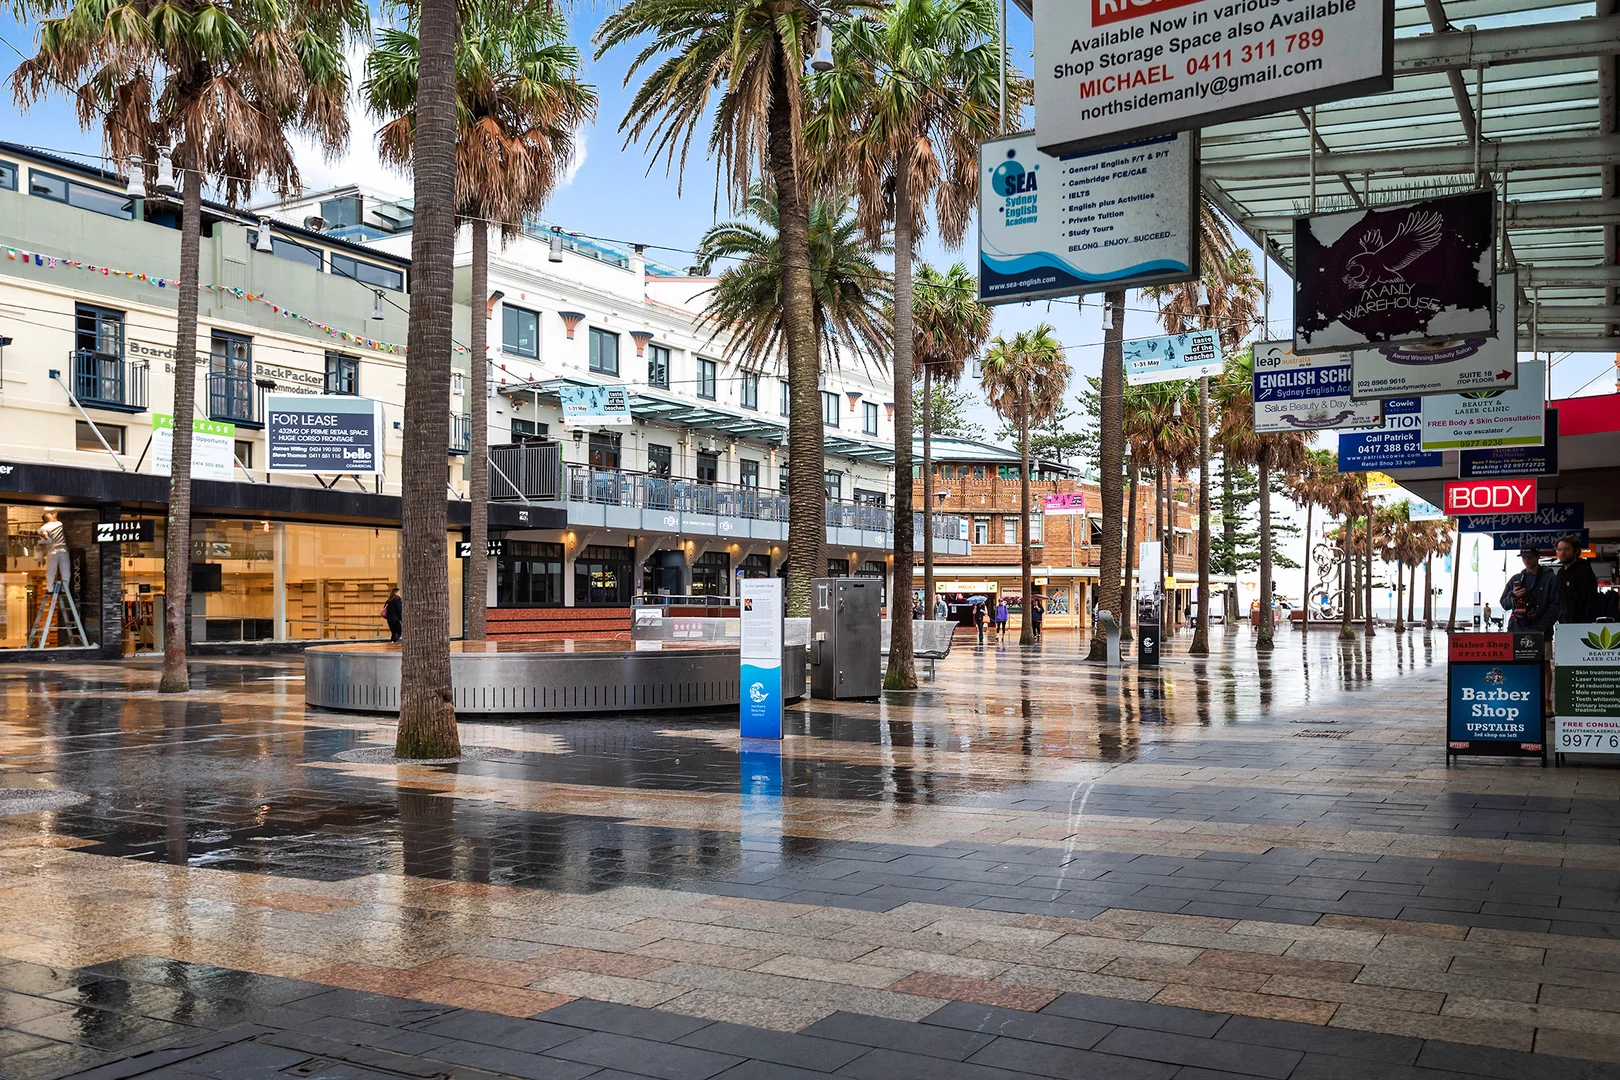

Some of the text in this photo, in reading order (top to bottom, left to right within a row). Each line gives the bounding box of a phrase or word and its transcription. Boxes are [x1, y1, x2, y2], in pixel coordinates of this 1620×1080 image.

[1069, 22, 1144, 54] Available
[1150, 17, 1187, 35] Now
[1192, 11, 1207, 28] in
[1053, 0, 1356, 80] Shop Storage Space also Available
[1079, 28, 1324, 100] MICHAEL 0411 311 789
[1080, 56, 1323, 121] northsidemanly@gmail.com
[1069, 163, 1098, 174] General
[1101, 158, 1129, 169] English
[1132, 154, 1145, 164] F/T
[1156, 150, 1169, 160] P/T
[1069, 167, 1147, 187] Cambridge FCE/CAE
[1005, 172, 1038, 196] SEA
[1005, 194, 1038, 207] Sydney
[1069, 190, 1090, 199] IELTS
[1069, 192, 1155, 213] English plus Activities
[1006, 204, 1037, 218] English
[1068, 210, 1124, 225] Private Tuition
[1005, 216, 1038, 227] Academy
[1068, 225, 1114, 238] Study Tours
[988, 276, 1056, 291] www.sea-english.com
[1361, 283, 1416, 302] MANLY
[1340, 297, 1440, 320] WAREHOUSE
[1193, 336, 1212, 344] taste
[1184, 353, 1214, 362] beaches
[1411, 353, 1433, 361] Winning
[1434, 351, 1455, 360] Beauty
[1456, 346, 1472, 356] Salon
[1256, 357, 1281, 367] leap
[256, 364, 323, 385] BackPacker
[1260, 368, 1351, 388] ENGLISH SCH
[1459, 371, 1482, 379] SUITE
[1277, 386, 1335, 398] Sydney English
[1358, 382, 1441, 393] www.salusbeautymanly.com
[1264, 404, 1288, 413] Salus
[1290, 401, 1319, 412] Beauty
[1330, 400, 1348, 409] Day
[1389, 400, 1414, 408] Cowie
[160, 417, 229, 433] FO LEASE
[272, 414, 338, 426] FOR LEASE
[1449, 419, 1467, 427] Body
[1494, 414, 1541, 423] Consultation
[196, 436, 228, 446] Opportunity
[1385, 433, 1414, 441] Patrick
[343, 447, 372, 459] belle
[1358, 442, 1421, 453] 0417 388 621
[1453, 485, 1531, 509] BODY
[115, 522, 140, 531] BILLA
[116, 533, 140, 542] BONG
[1487, 642, 1510, 651] Shop
[1461, 688, 1530, 701] Barber
[1472, 704, 1519, 721] Shop
[1466, 723, 1524, 732] UPSTAIRS
[1562, 734, 1603, 747] 9977
